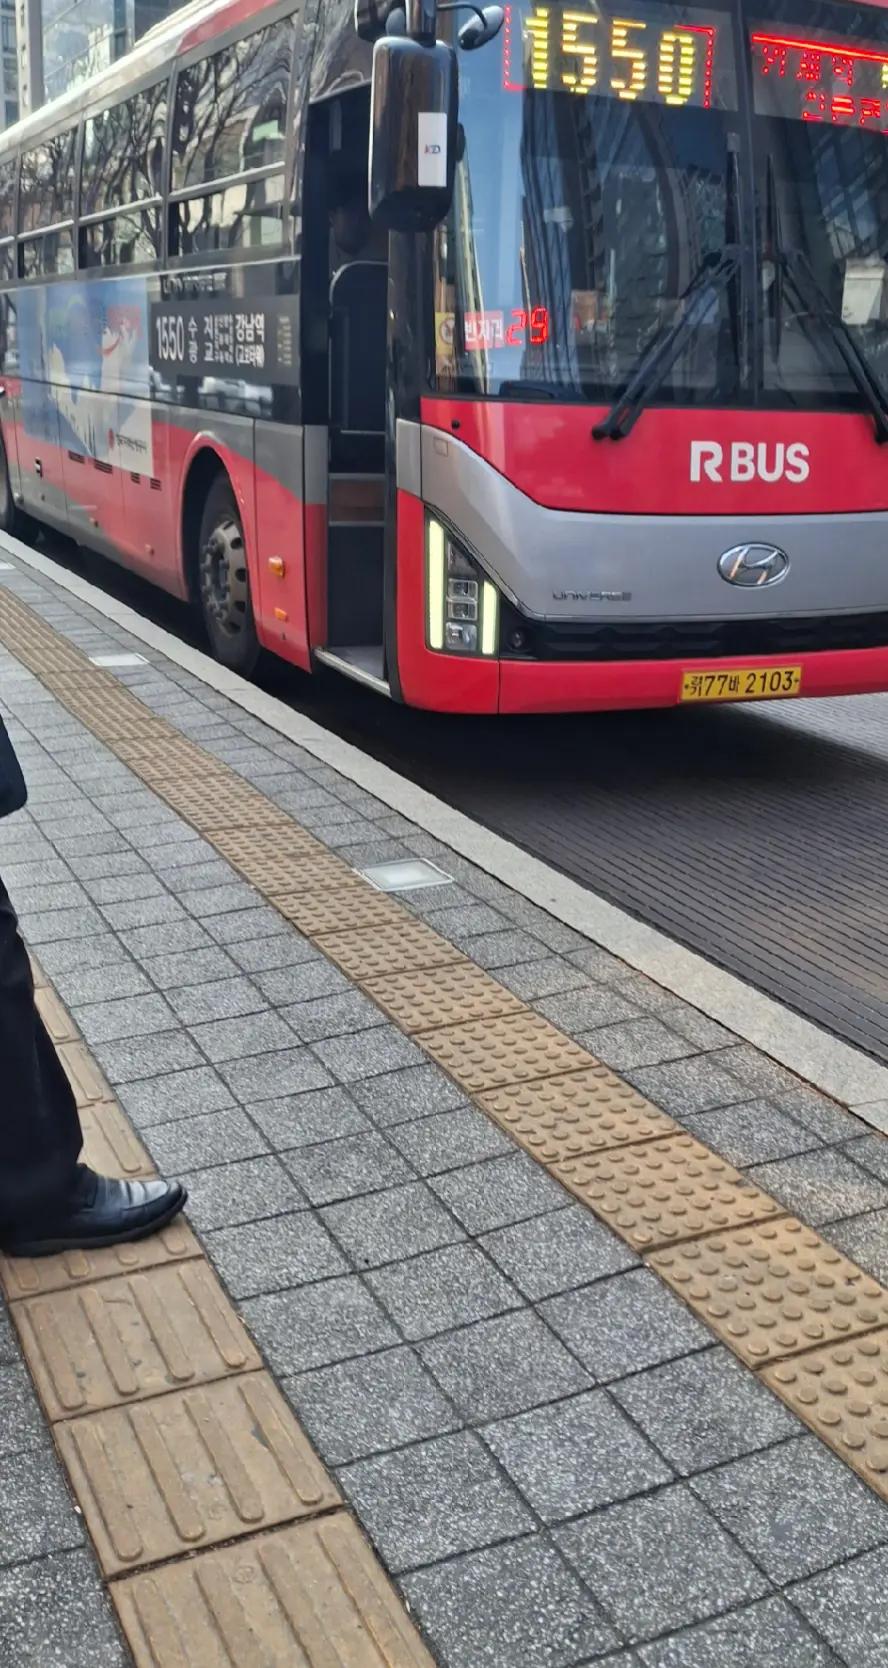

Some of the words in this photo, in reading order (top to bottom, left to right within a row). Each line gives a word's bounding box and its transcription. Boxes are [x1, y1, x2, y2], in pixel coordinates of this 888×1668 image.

[526, 8, 695, 105] 1550
[156, 316, 185, 361] 1550
[235, 313, 265, 342] 강남역
[505, 305, 549, 345] 29
[690, 440, 724, 482] R
[731, 442, 811, 483] BUS
[745, 671, 795, 694] 2103
